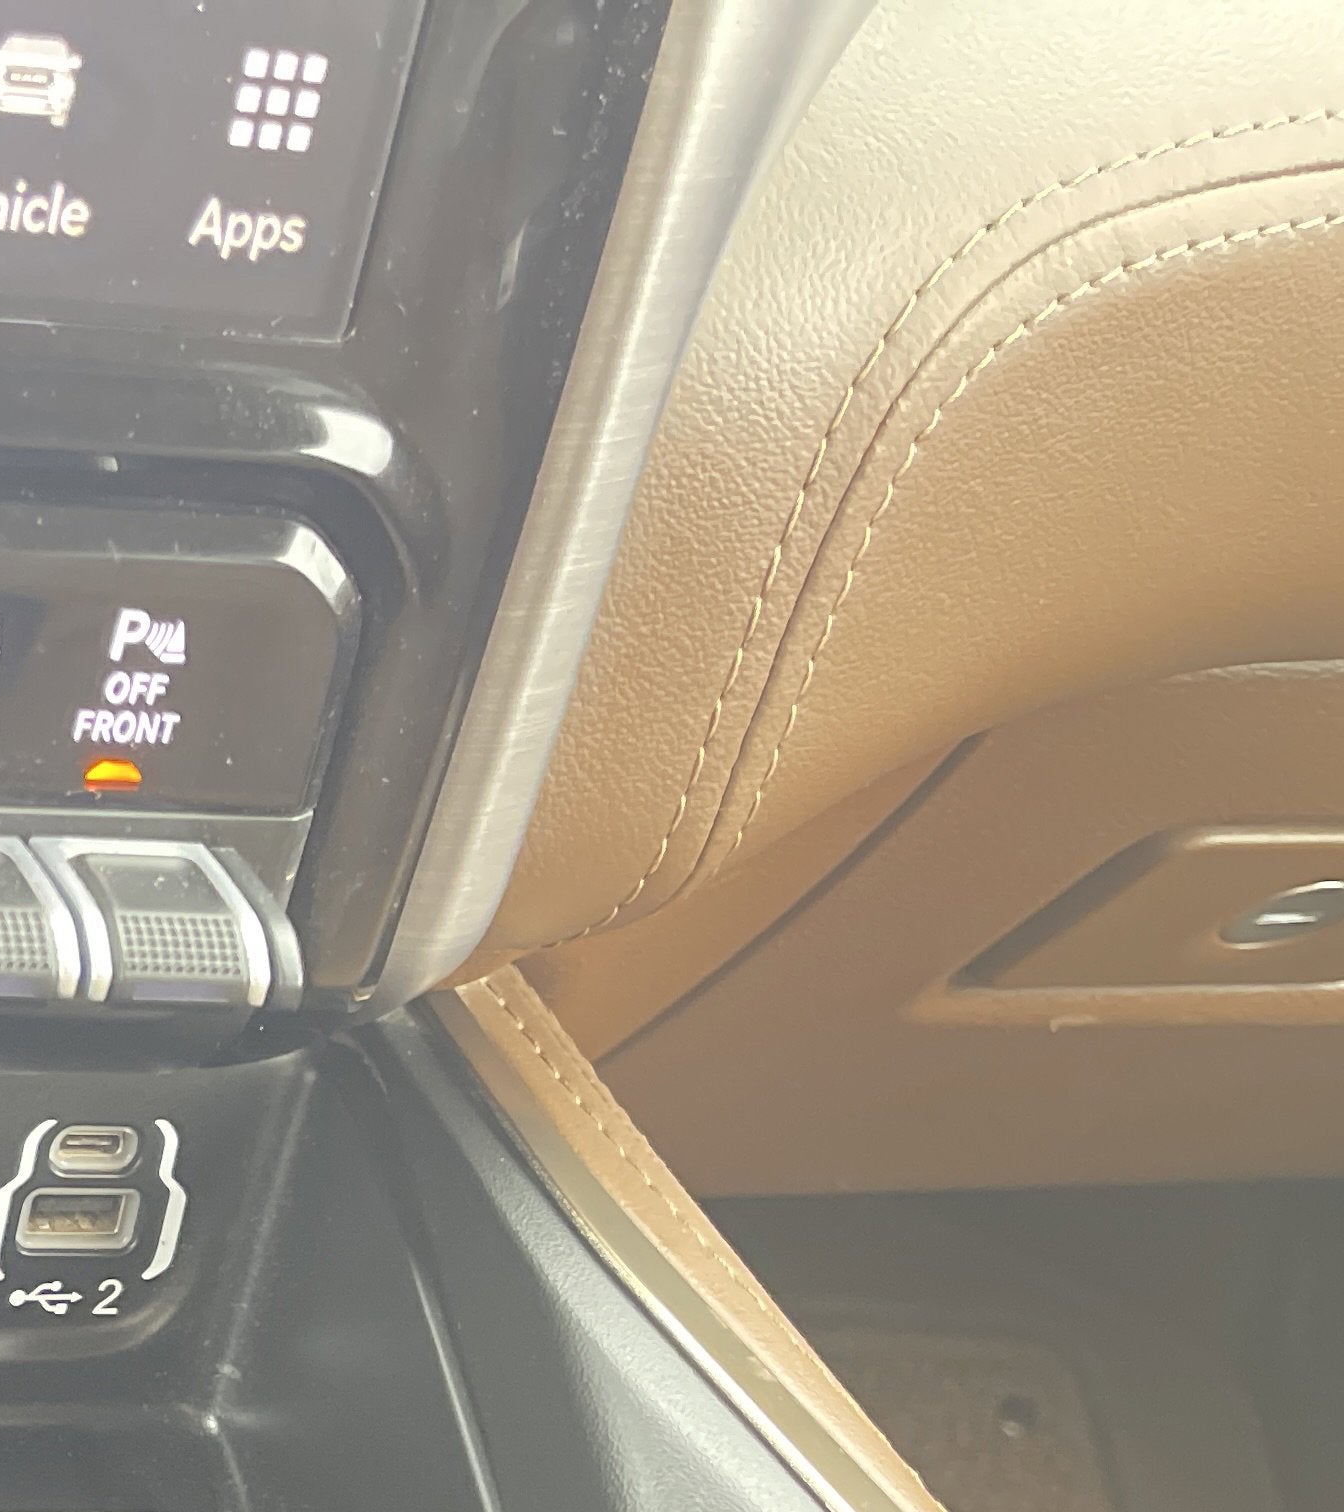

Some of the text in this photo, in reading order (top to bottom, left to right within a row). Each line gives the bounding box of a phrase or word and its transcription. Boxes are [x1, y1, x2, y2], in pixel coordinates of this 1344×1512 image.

[187, 196, 307, 263] Apps
[103, 670, 170, 707] OFF
[72, 709, 182, 745] FRONT
[90, 1277, 125, 1317] 2
